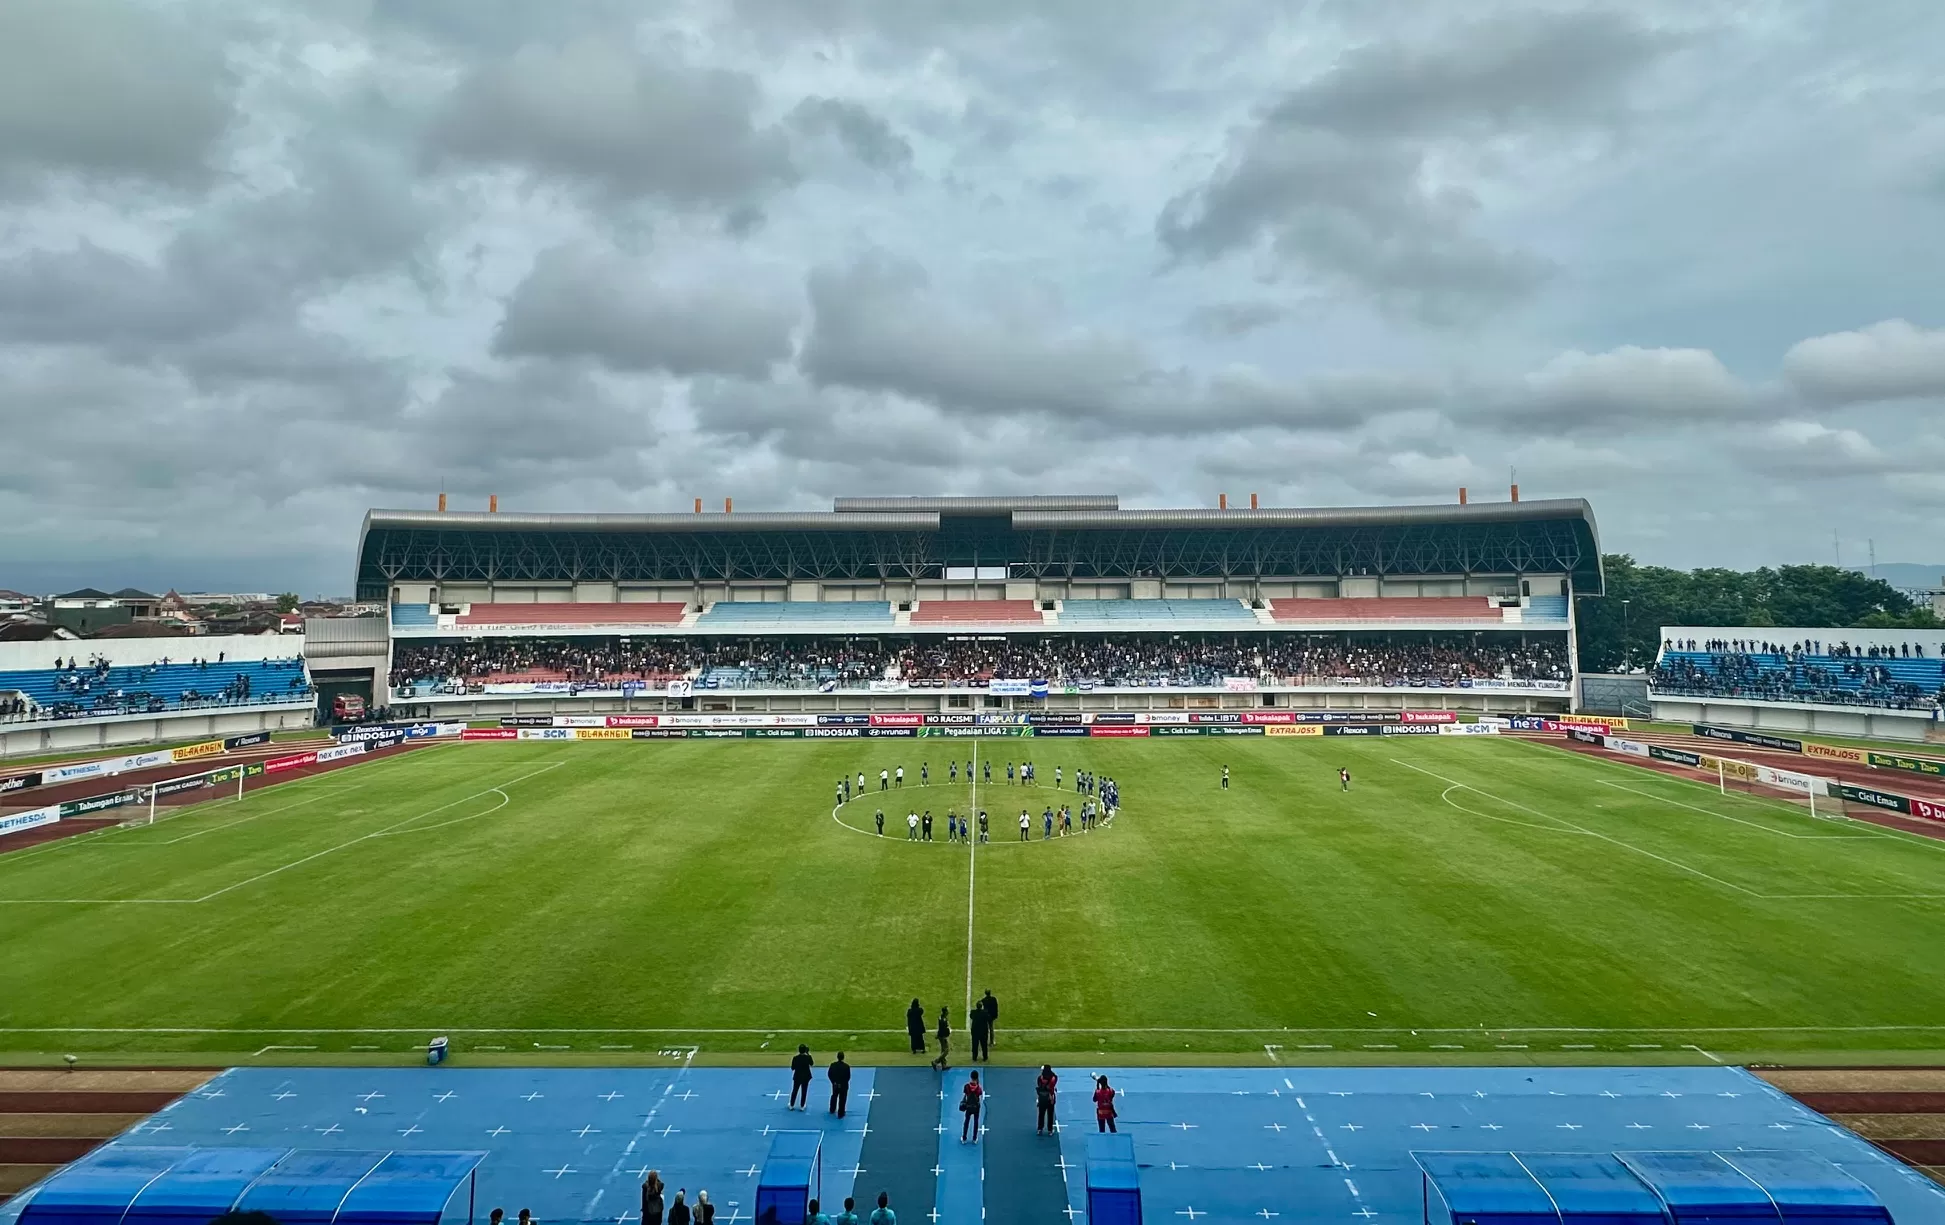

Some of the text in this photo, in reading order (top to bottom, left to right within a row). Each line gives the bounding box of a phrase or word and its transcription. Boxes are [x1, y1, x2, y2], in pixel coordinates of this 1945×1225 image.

[543, 729, 567, 738] SCM
[944, 727, 982, 736] Pegadaian
[1392, 725, 1437, 733] INDOSIAR
[1466, 725, 1489, 733] SCM
[1778, 775, 1810, 788] bmone
[79, 797, 114, 811] Tabungan
[1858, 791, 1876, 804] Cicil
[1877, 795, 1898, 808] Emas
